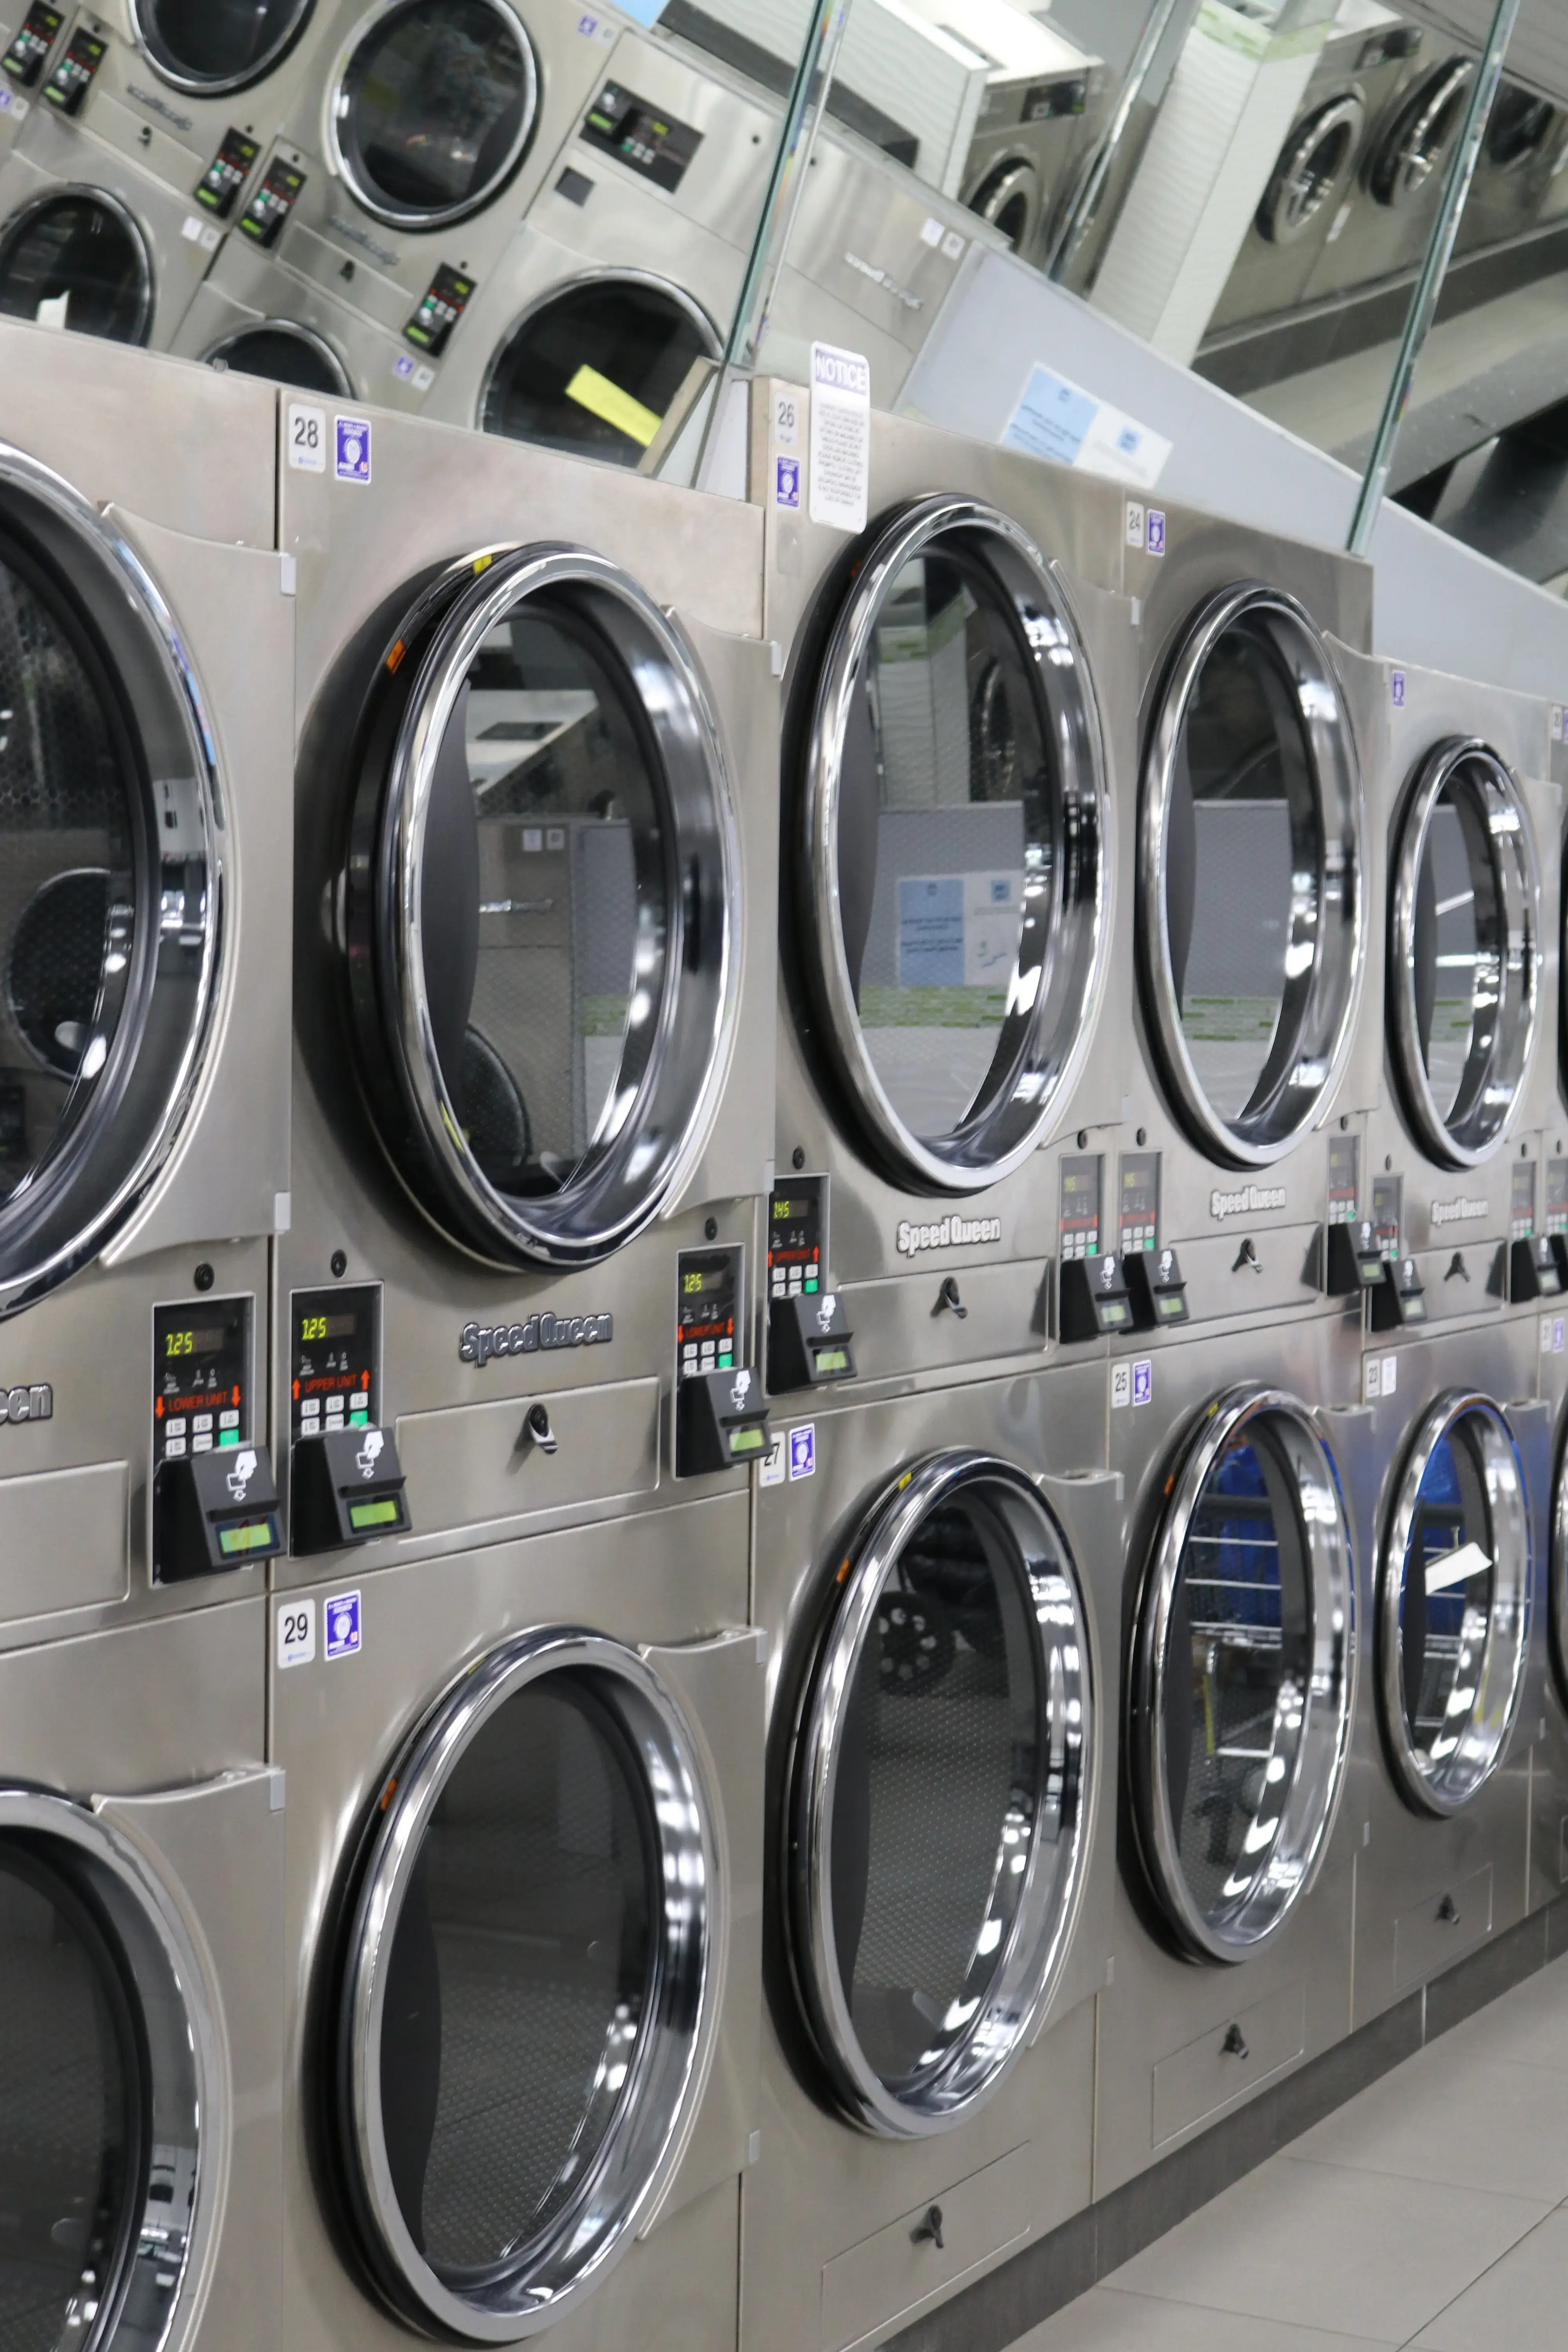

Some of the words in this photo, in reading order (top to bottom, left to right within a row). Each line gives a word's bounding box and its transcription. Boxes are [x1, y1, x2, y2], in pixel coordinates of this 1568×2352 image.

[816, 354, 867, 391] NOTICE
[778, 401, 795, 428] 26
[294, 416, 319, 448] 28
[1129, 510, 1141, 531] 24
[305, 1376, 335, 1394] UPPER
[337, 1374, 357, 1388] UNIT
[1115, 1371, 1127, 1392] 25
[1369, 1365, 1378, 1384] 23
[168, 1394, 204, 1412] LOWER
[206, 1390, 228, 1407] UNIT
[285, 1612, 308, 1644] 29
